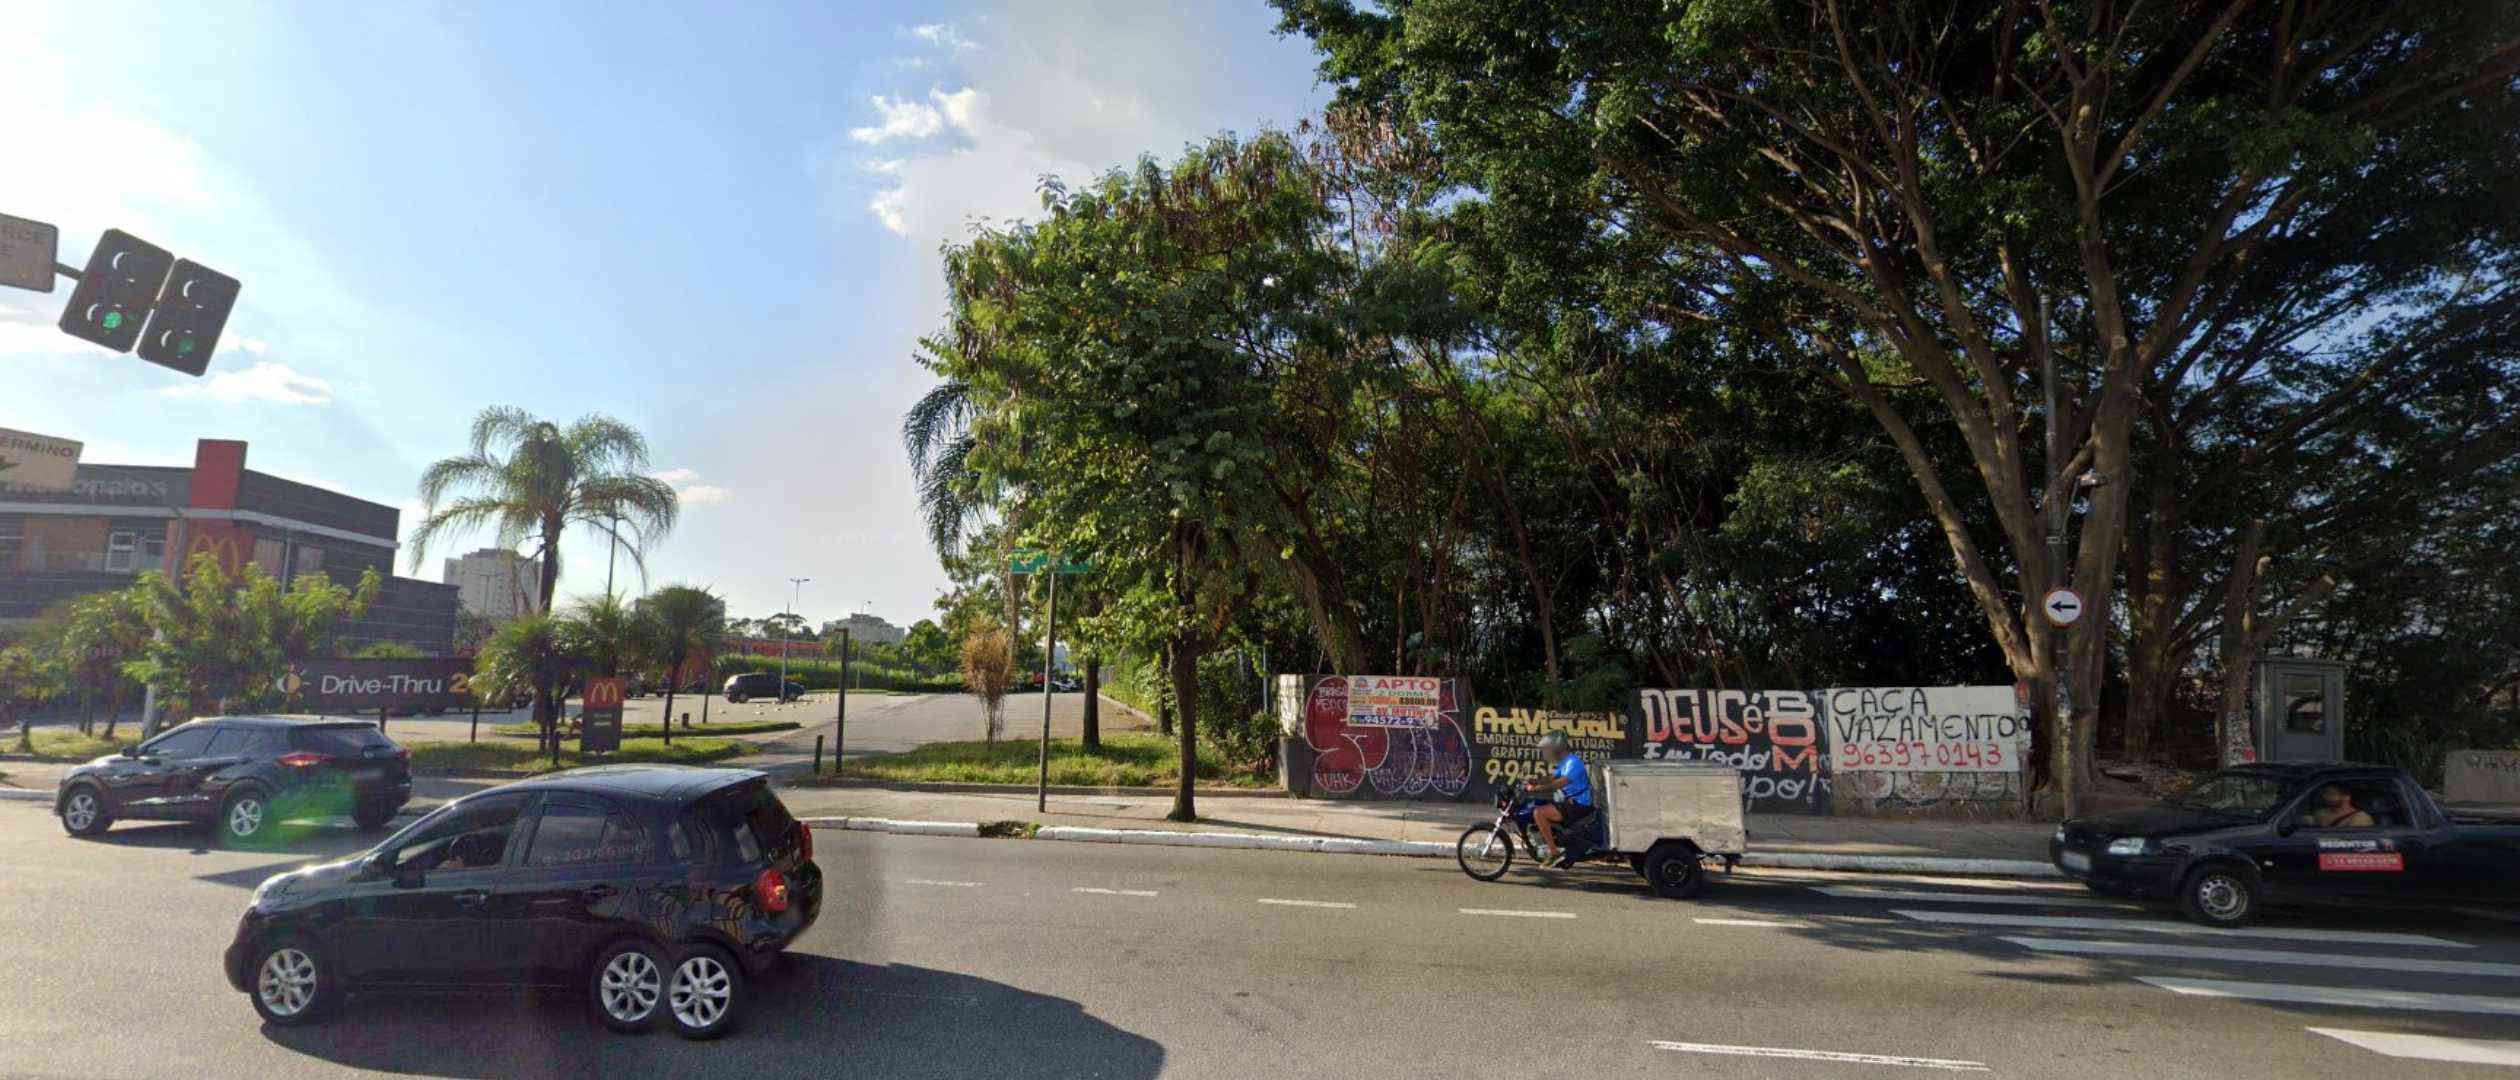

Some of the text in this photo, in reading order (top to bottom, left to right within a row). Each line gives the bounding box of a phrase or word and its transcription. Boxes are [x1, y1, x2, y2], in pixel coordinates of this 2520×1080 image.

[321, 674, 442, 694] Drive-Thru
[1375, 679, 1437, 691] APTO
[1641, 689, 1749, 745] DEUS
